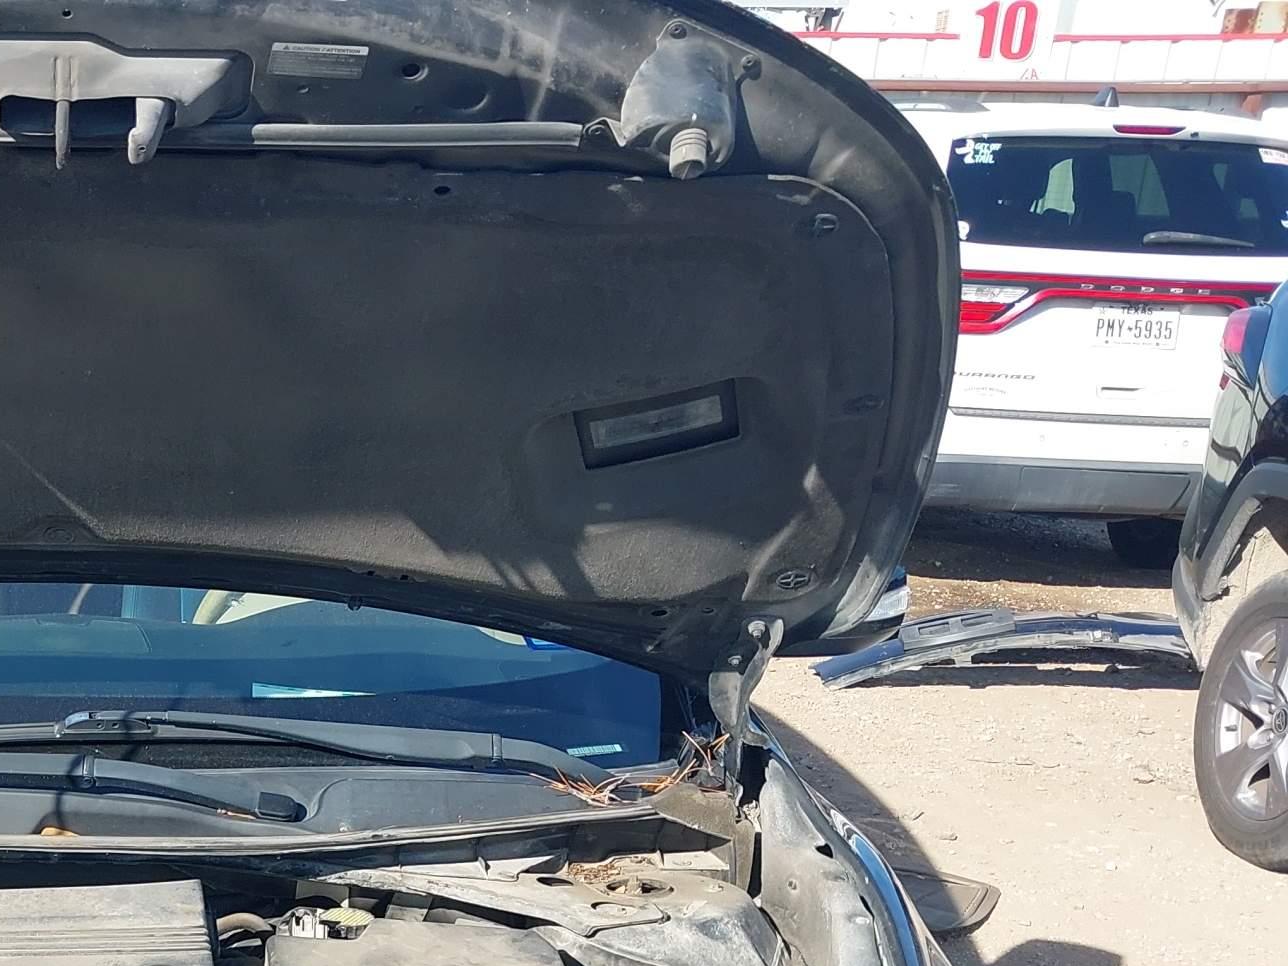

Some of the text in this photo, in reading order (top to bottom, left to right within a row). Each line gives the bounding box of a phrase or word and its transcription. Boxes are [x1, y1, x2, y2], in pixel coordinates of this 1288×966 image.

[975, 0, 1039, 60] 10
[1080, 283, 1211, 295] DODGE
[1120, 305, 1154, 316] TEXAS
